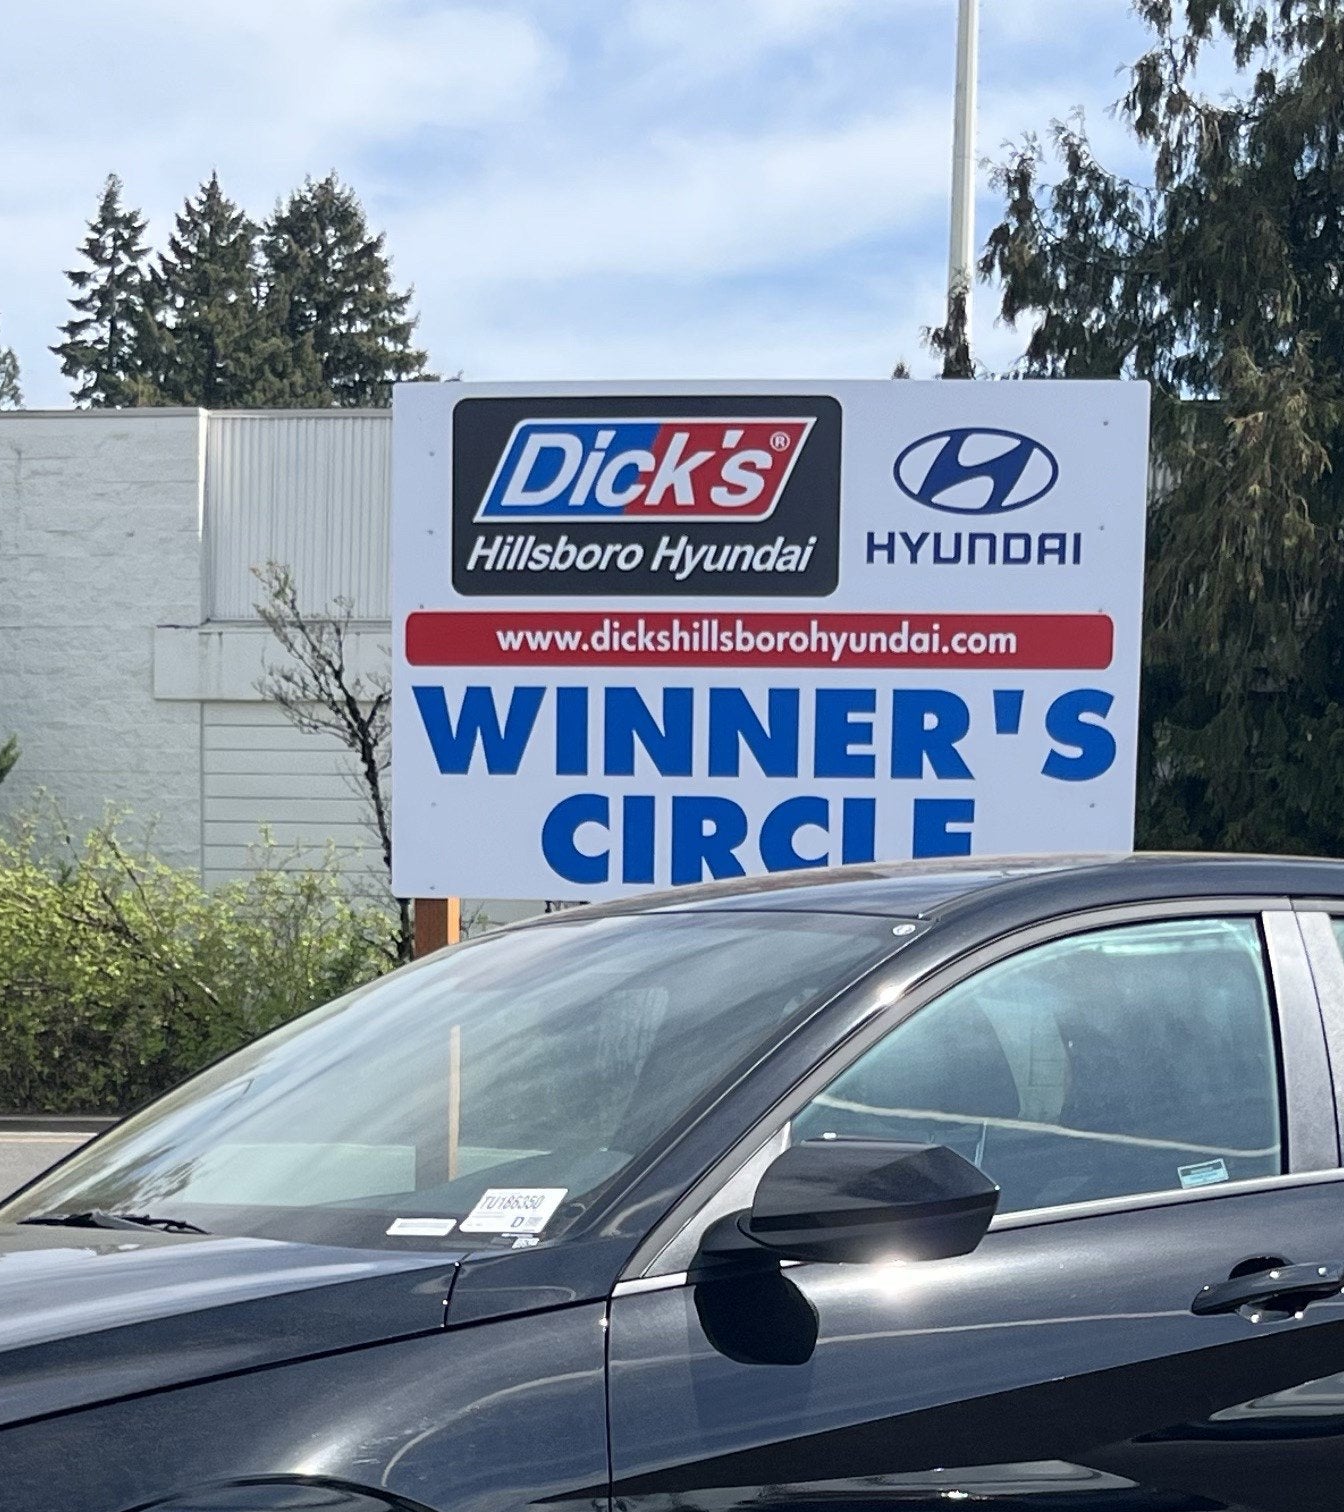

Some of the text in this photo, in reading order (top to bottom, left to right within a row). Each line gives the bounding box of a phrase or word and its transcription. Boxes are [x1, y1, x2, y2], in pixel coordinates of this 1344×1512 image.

[500, 429, 774, 508] Dick's
[466, 535, 817, 581] Hillsboro Hyundai
[865, 531, 1083, 566] HYUNDAI
[496, 618, 1017, 662] www.dickshillsborohyundai.com
[411, 685, 1118, 782] WINNER'S
